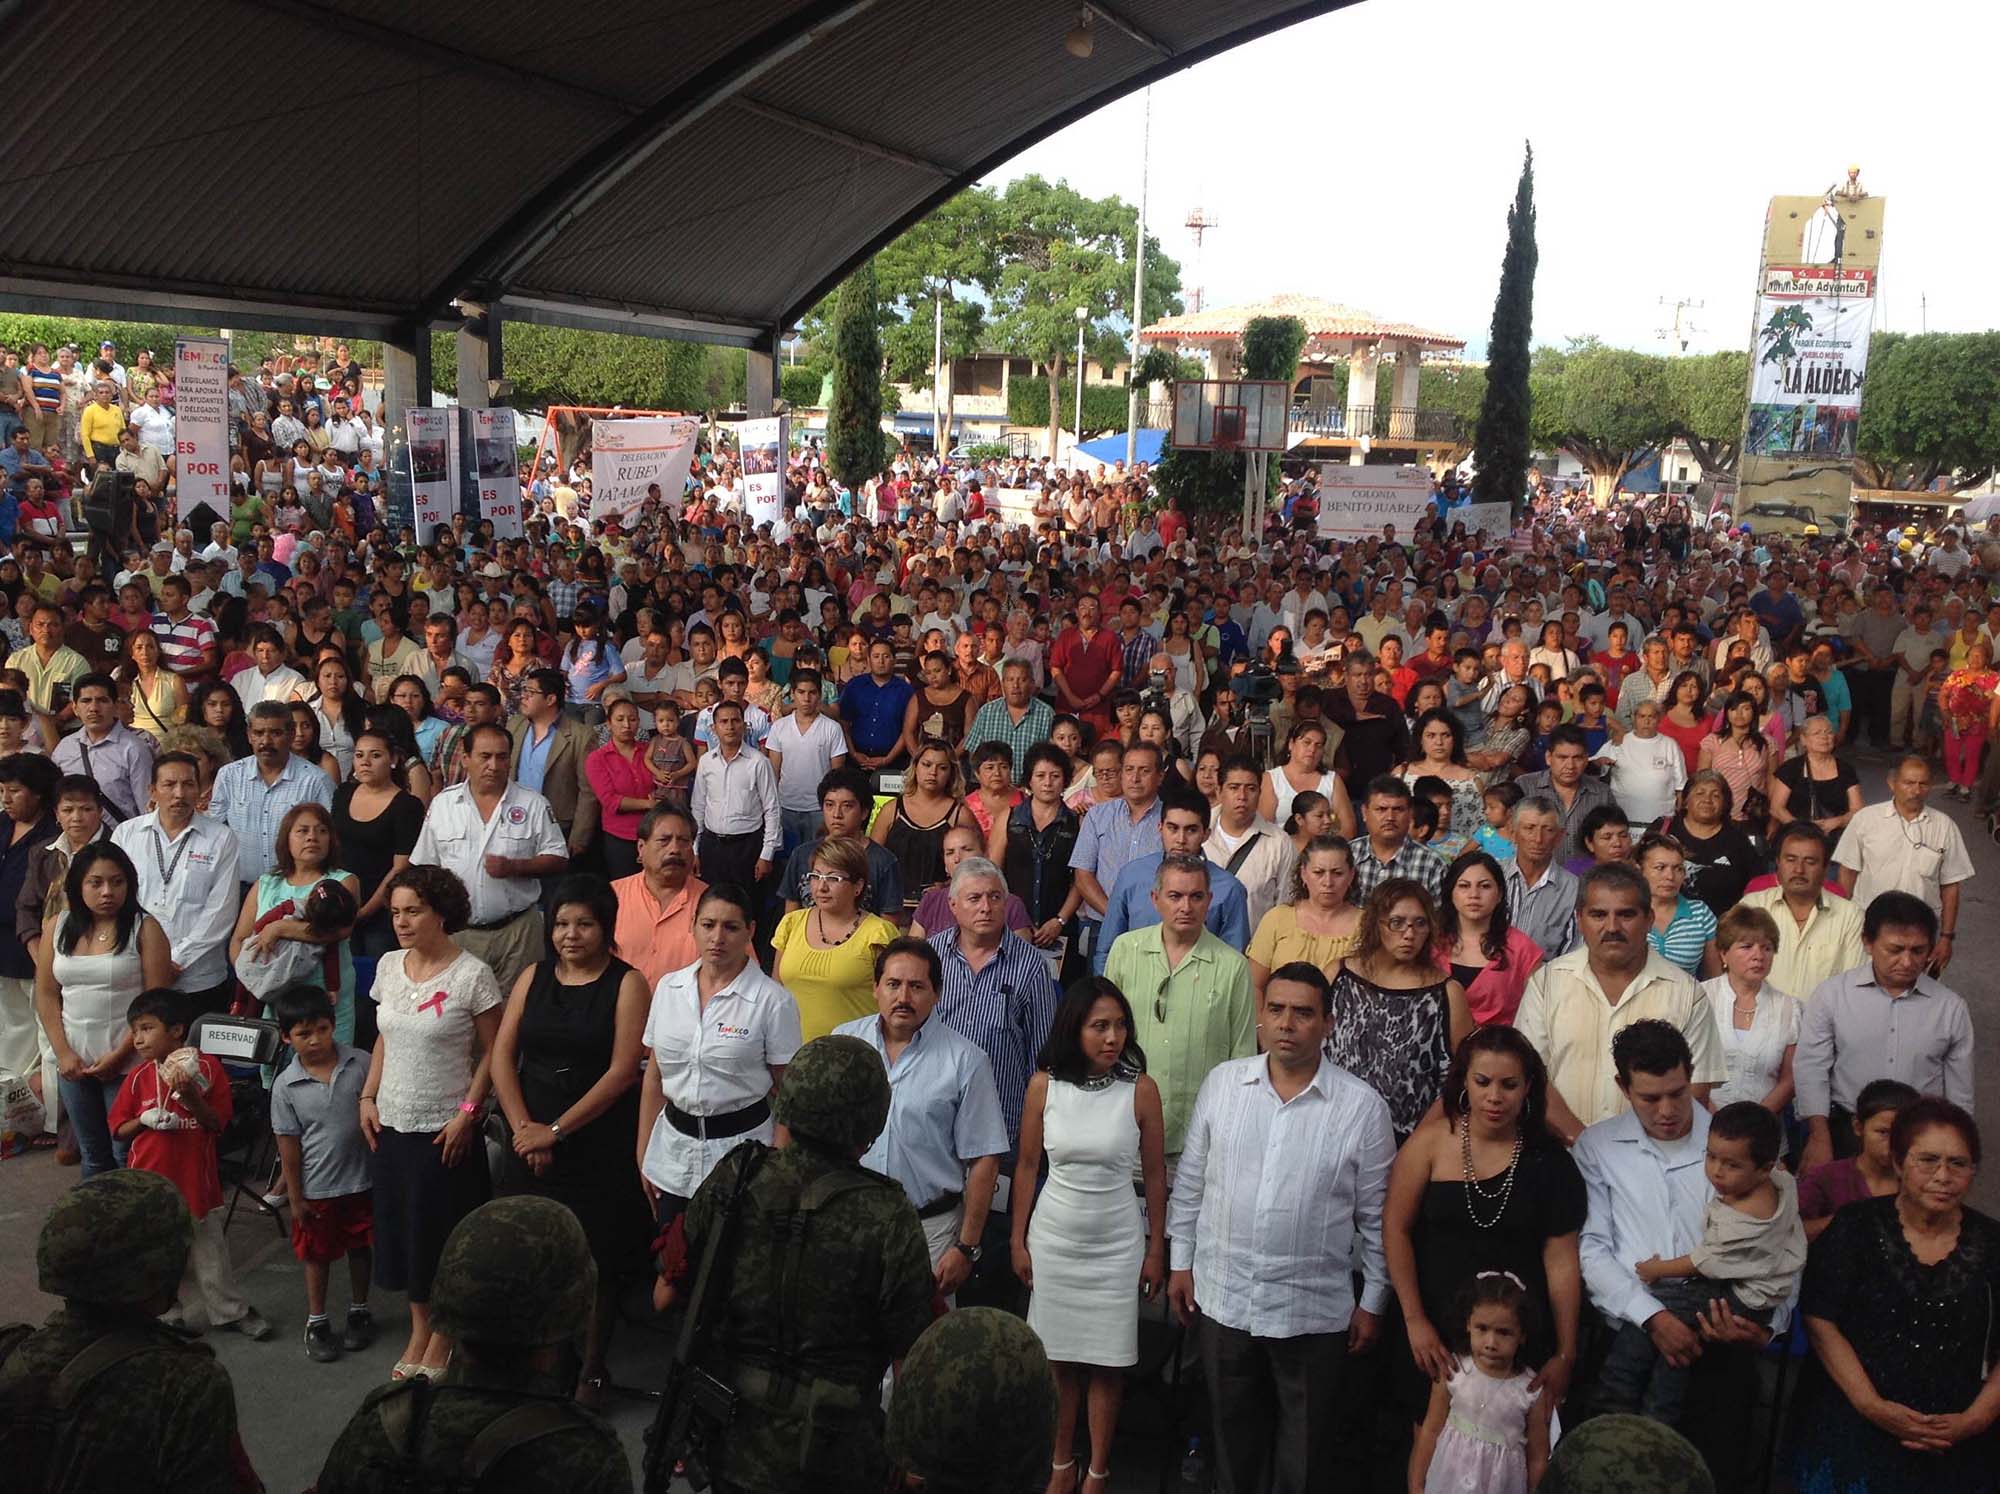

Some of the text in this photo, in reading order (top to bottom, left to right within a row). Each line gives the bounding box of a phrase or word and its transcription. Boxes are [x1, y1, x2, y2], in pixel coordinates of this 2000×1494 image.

[1792, 280, 1814, 292] Safe
[1816, 280, 1866, 293] Adventure
[181, 376, 219, 386] LEGISLAMOS
[1784, 367, 1851, 395] LA ALDEA
[184, 405, 220, 414] DELEGADOS
[181, 415, 221, 424] MUNICIPALES
[177, 441, 196, 454] ES
[187, 463, 219, 475] POR
[211, 483, 228, 496] TI
[749, 483, 762, 492] ES
[483, 490, 497, 500] ES
[1352, 489, 1397, 499] COLONIA
[416, 495, 428, 505] ES
[490, 505, 516, 516] POR
[1327, 501, 1422, 514] BENITO JUAREZ
[104, 638, 119, 652] 92
[208, 1030, 257, 1044] RESERVAD
